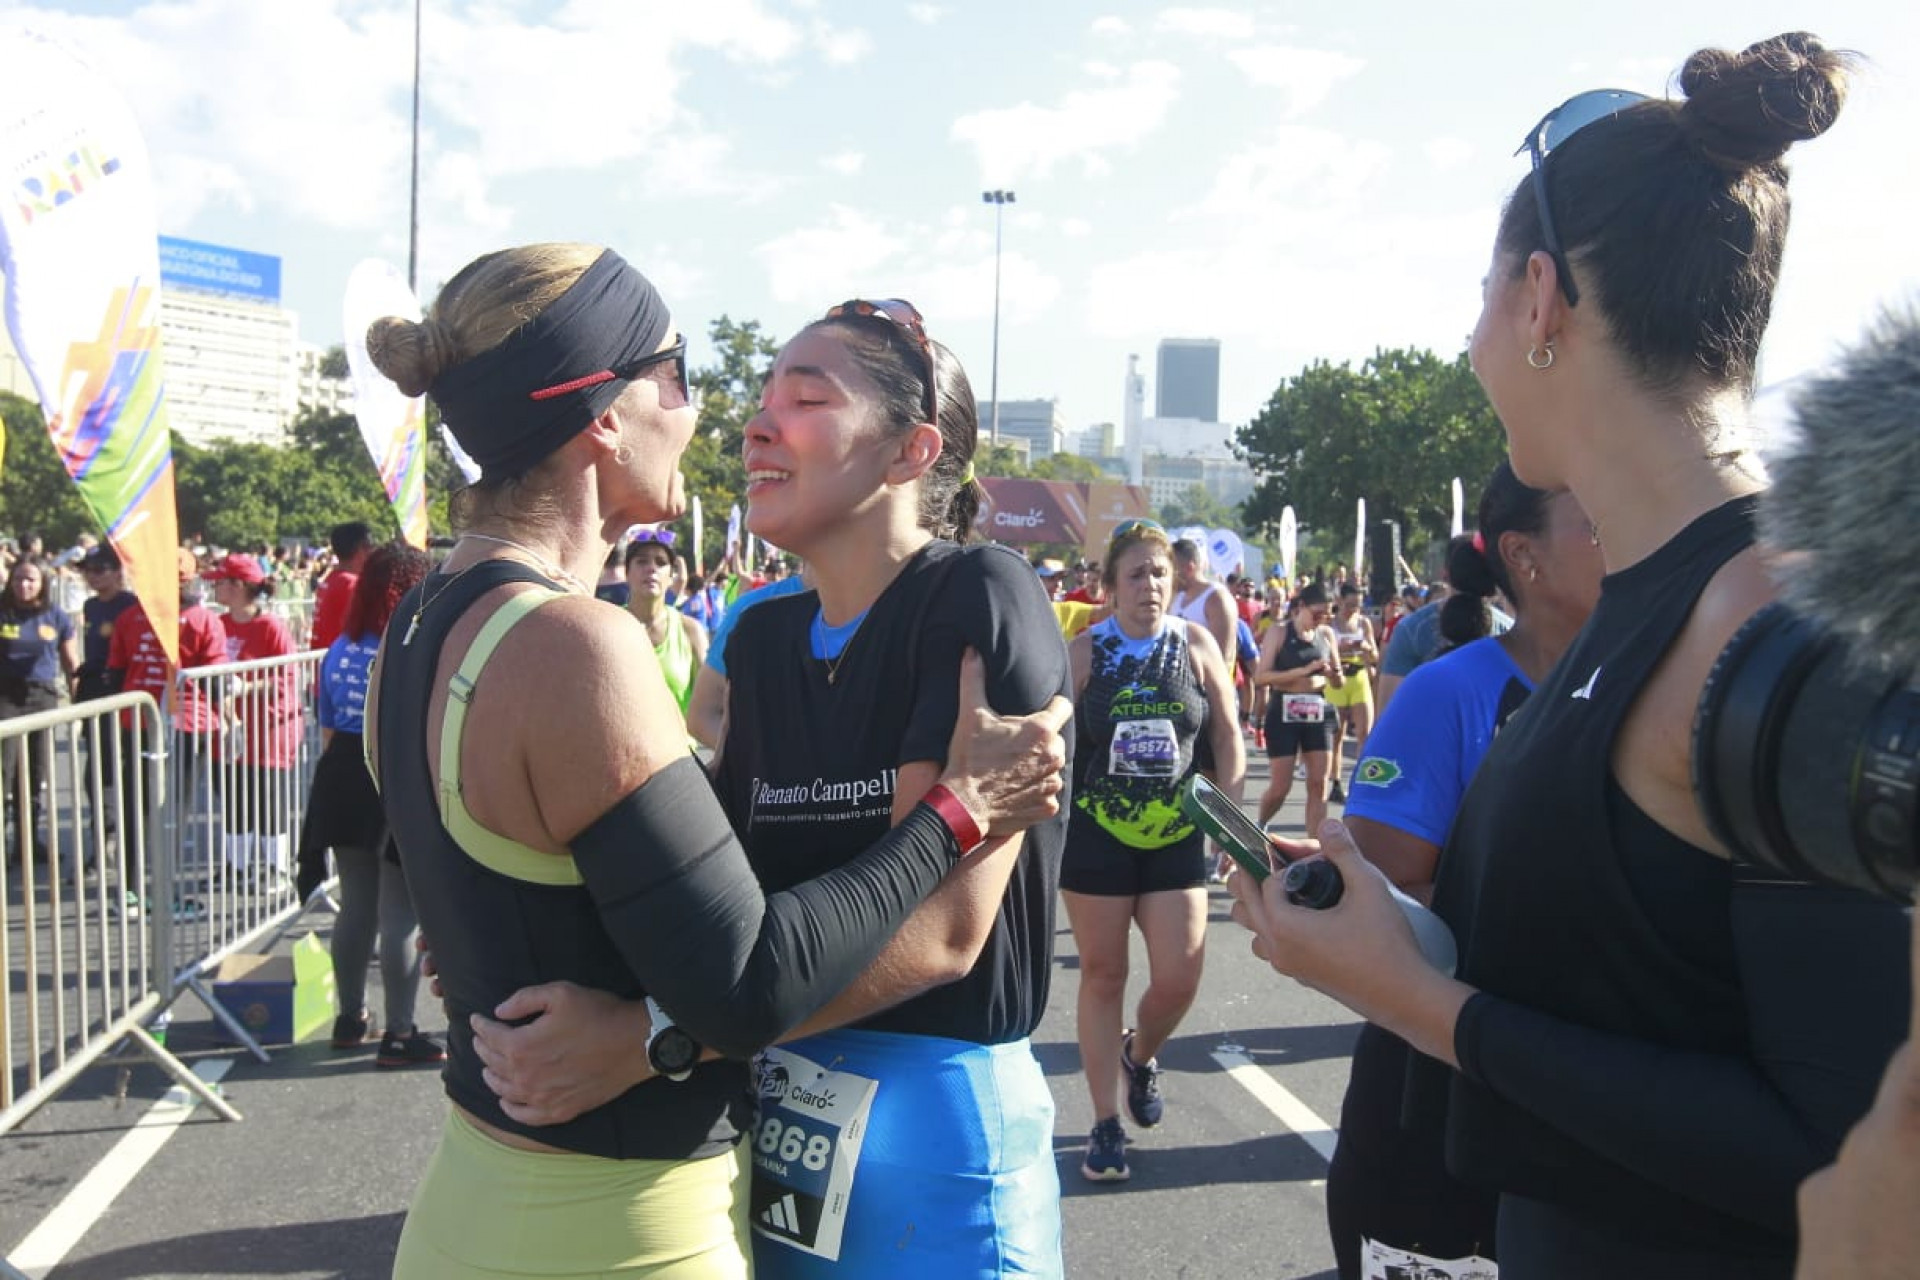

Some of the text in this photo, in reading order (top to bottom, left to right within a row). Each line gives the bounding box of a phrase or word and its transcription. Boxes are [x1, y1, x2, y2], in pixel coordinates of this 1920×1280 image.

[994, 511, 1037, 528] Claro
[1110, 702, 1184, 717] ATENEO
[757, 782, 809, 804] Renato
[791, 1086, 828, 1110] Claro
